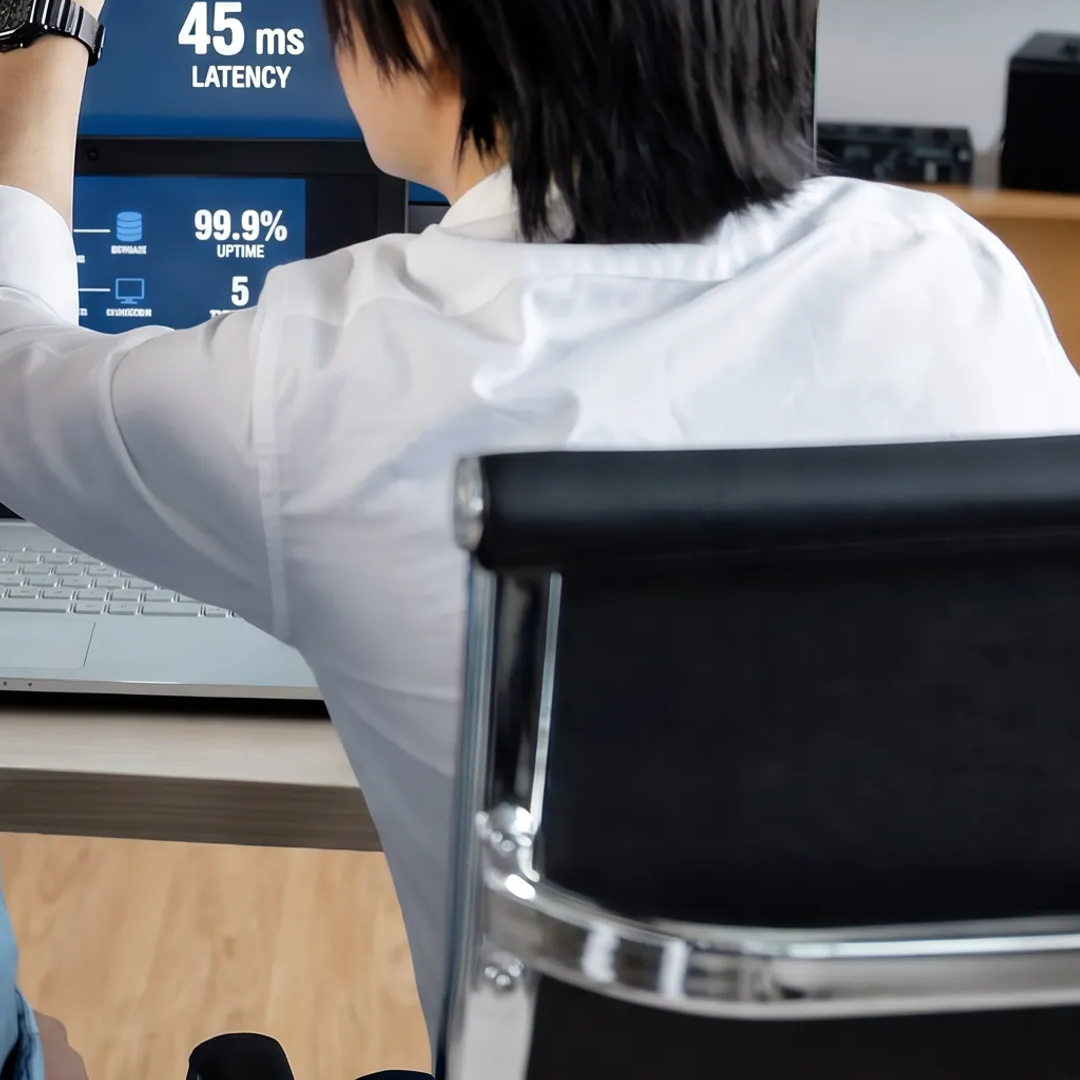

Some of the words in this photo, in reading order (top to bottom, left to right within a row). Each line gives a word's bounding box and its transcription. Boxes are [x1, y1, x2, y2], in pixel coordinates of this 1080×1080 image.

[178, 1, 245, 56] 45
[255, 27, 305, 56] ms
[192, 65, 292, 89] LATENCY
[194, 209, 288, 242] 99.9%
[216, 243, 265, 259] UPTIME
[231, 275, 250, 306] 5
